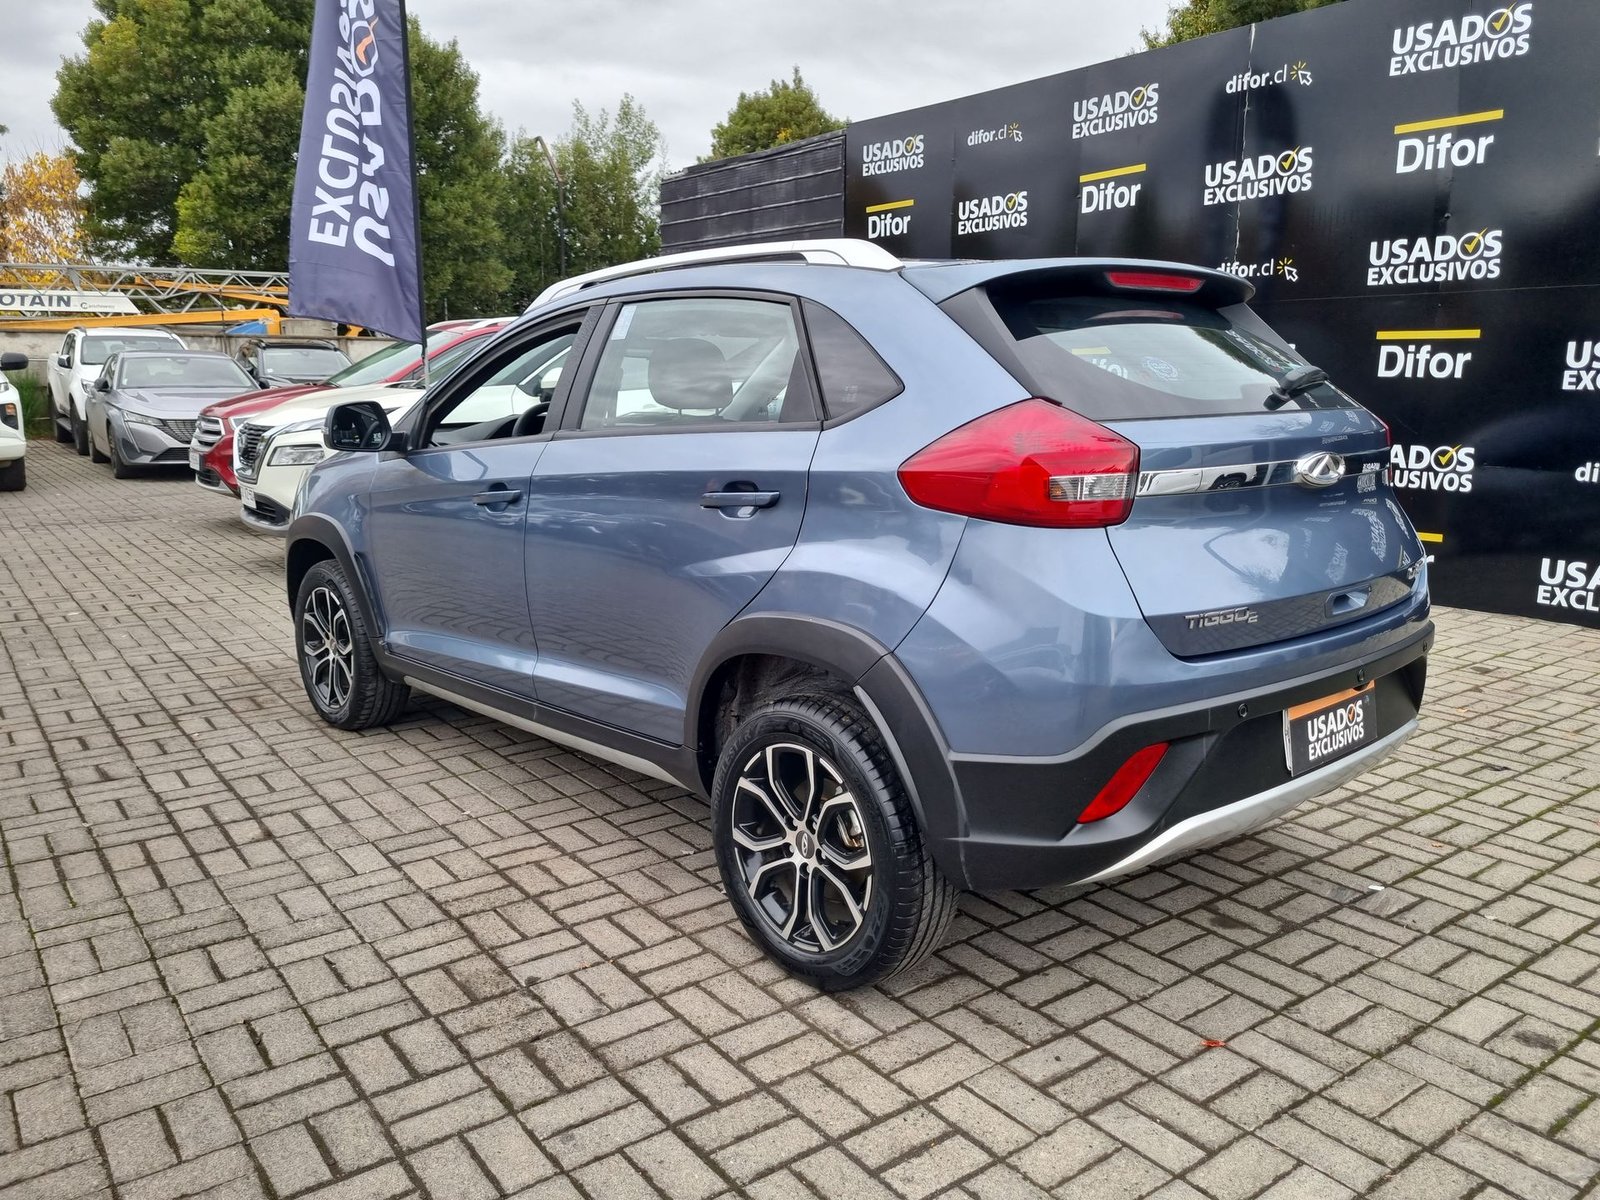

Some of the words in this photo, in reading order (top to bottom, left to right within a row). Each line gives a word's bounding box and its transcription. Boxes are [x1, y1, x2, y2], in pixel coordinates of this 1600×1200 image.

[1393, 3, 1533, 55] USADOS
[1389, 34, 1530, 76] EXCLUSIVOS
[1225, 64, 1287, 94] difor.cl
[1073, 84, 1159, 122] USADOS
[967, 125, 1007, 146] difor.cl
[1072, 107, 1158, 139] EXCLUSIVOS
[862, 135, 924, 162] USADOS
[1396, 134, 1494, 174] Difor
[862, 154, 924, 177] EXCLUSIVOS
[1205, 147, 1313, 187] USADOS
[958, 191, 1028, 220] USADOS
[1081, 182, 1142, 214] Difor
[1203, 173, 1313, 206] EXCLUSIVOS
[868, 213, 911, 239] Difor
[957, 212, 1028, 235] EXCLUSIVOS
[1369, 229, 1503, 266] USADOS
[1367, 258, 1501, 286] EXCLUSIVOS
[1377, 345, 1472, 379] Difor
[1390, 444, 1475, 472] ADOS
[1390, 470, 1473, 492] USIVOS
[1307, 699, 1364, 742] USADOS
[1308, 721, 1364, 761] EXCLUSIVOS
